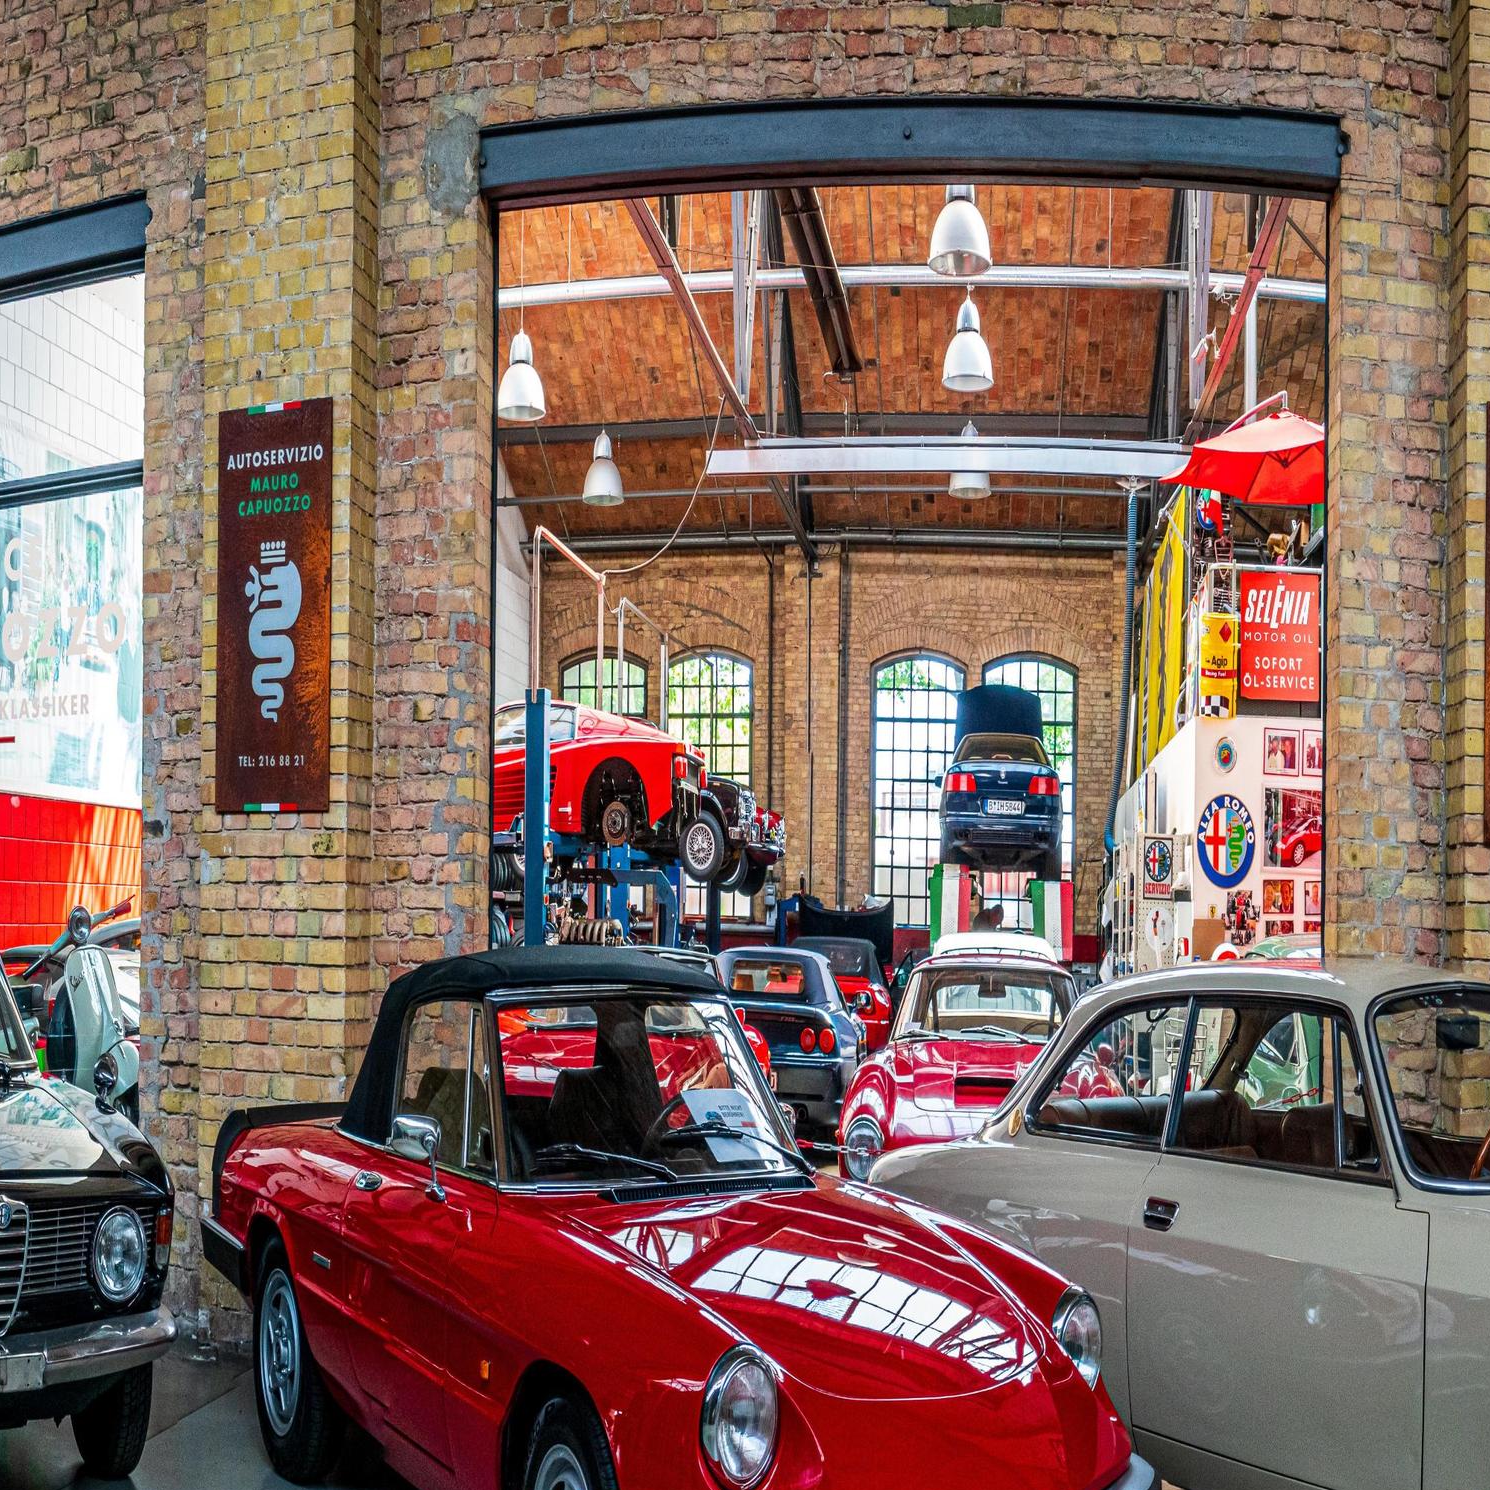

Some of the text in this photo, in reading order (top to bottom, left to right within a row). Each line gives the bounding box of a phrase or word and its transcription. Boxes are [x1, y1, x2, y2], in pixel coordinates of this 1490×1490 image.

[227, 444, 323, 470] AUTOSERVIZIO
[250, 472, 299, 493] MAURO
[238, 495, 311, 517] CAPUOZZO
[1244, 632, 1313, 644] MOTOR OIL
[1211, 656, 1228, 668] Agip
[1254, 656, 1303, 671] SOFORT
[1243, 672, 1315, 690] ÖL-SERVICE
[238, 754, 304, 767] TEL: 216 88 21
[1198, 796, 1255, 844] ALFA ROMEO
